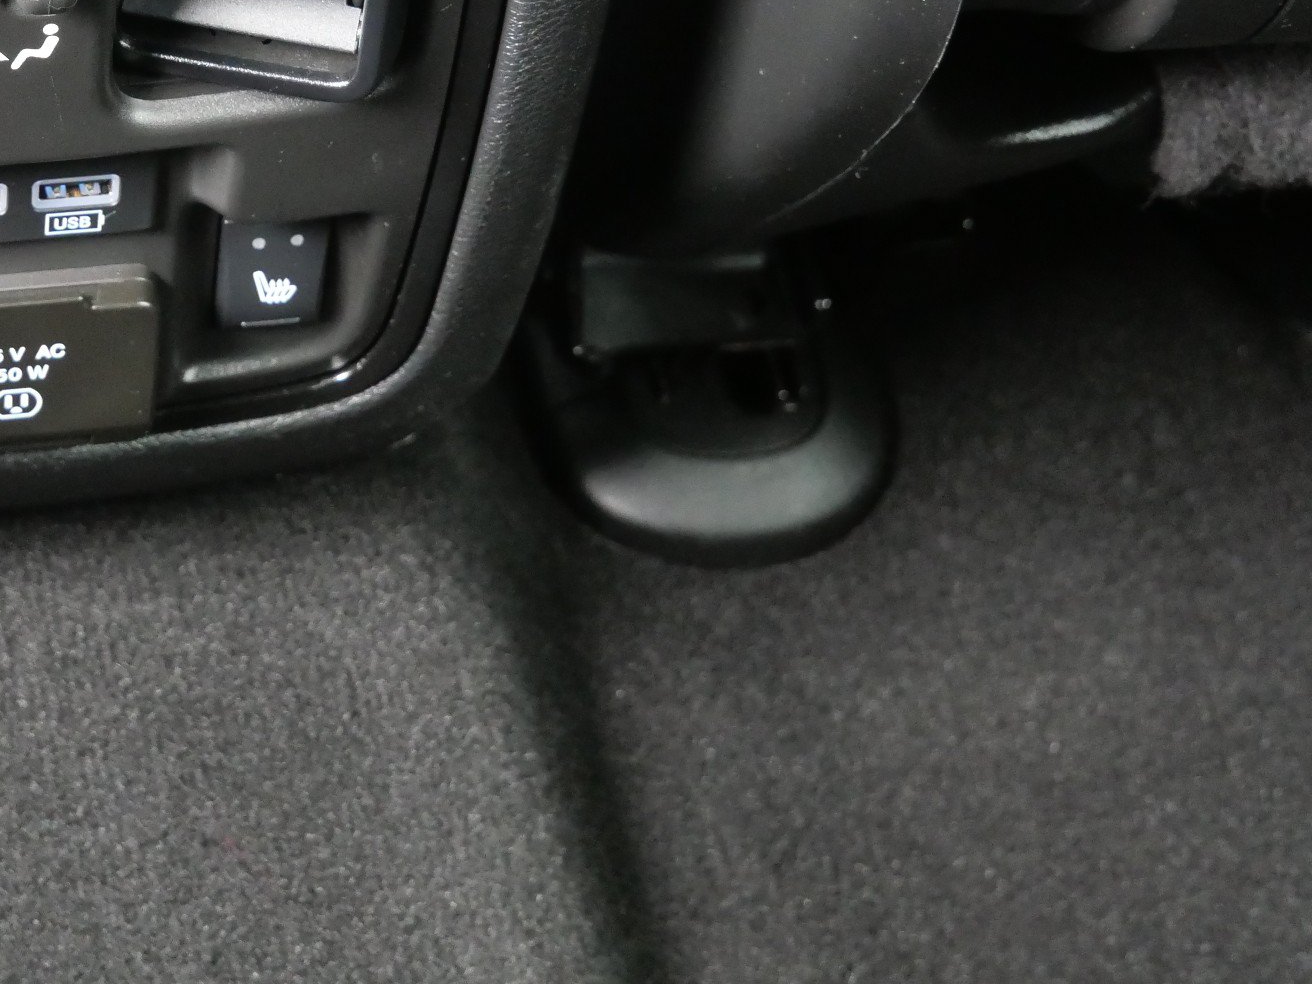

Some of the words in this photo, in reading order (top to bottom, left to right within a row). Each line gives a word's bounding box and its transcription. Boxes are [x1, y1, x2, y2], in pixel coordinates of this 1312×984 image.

[53, 215, 91, 230] USB
[9, 346, 26, 362] V
[35, 343, 66, 360] AC
[27, 364, 49, 380] W
